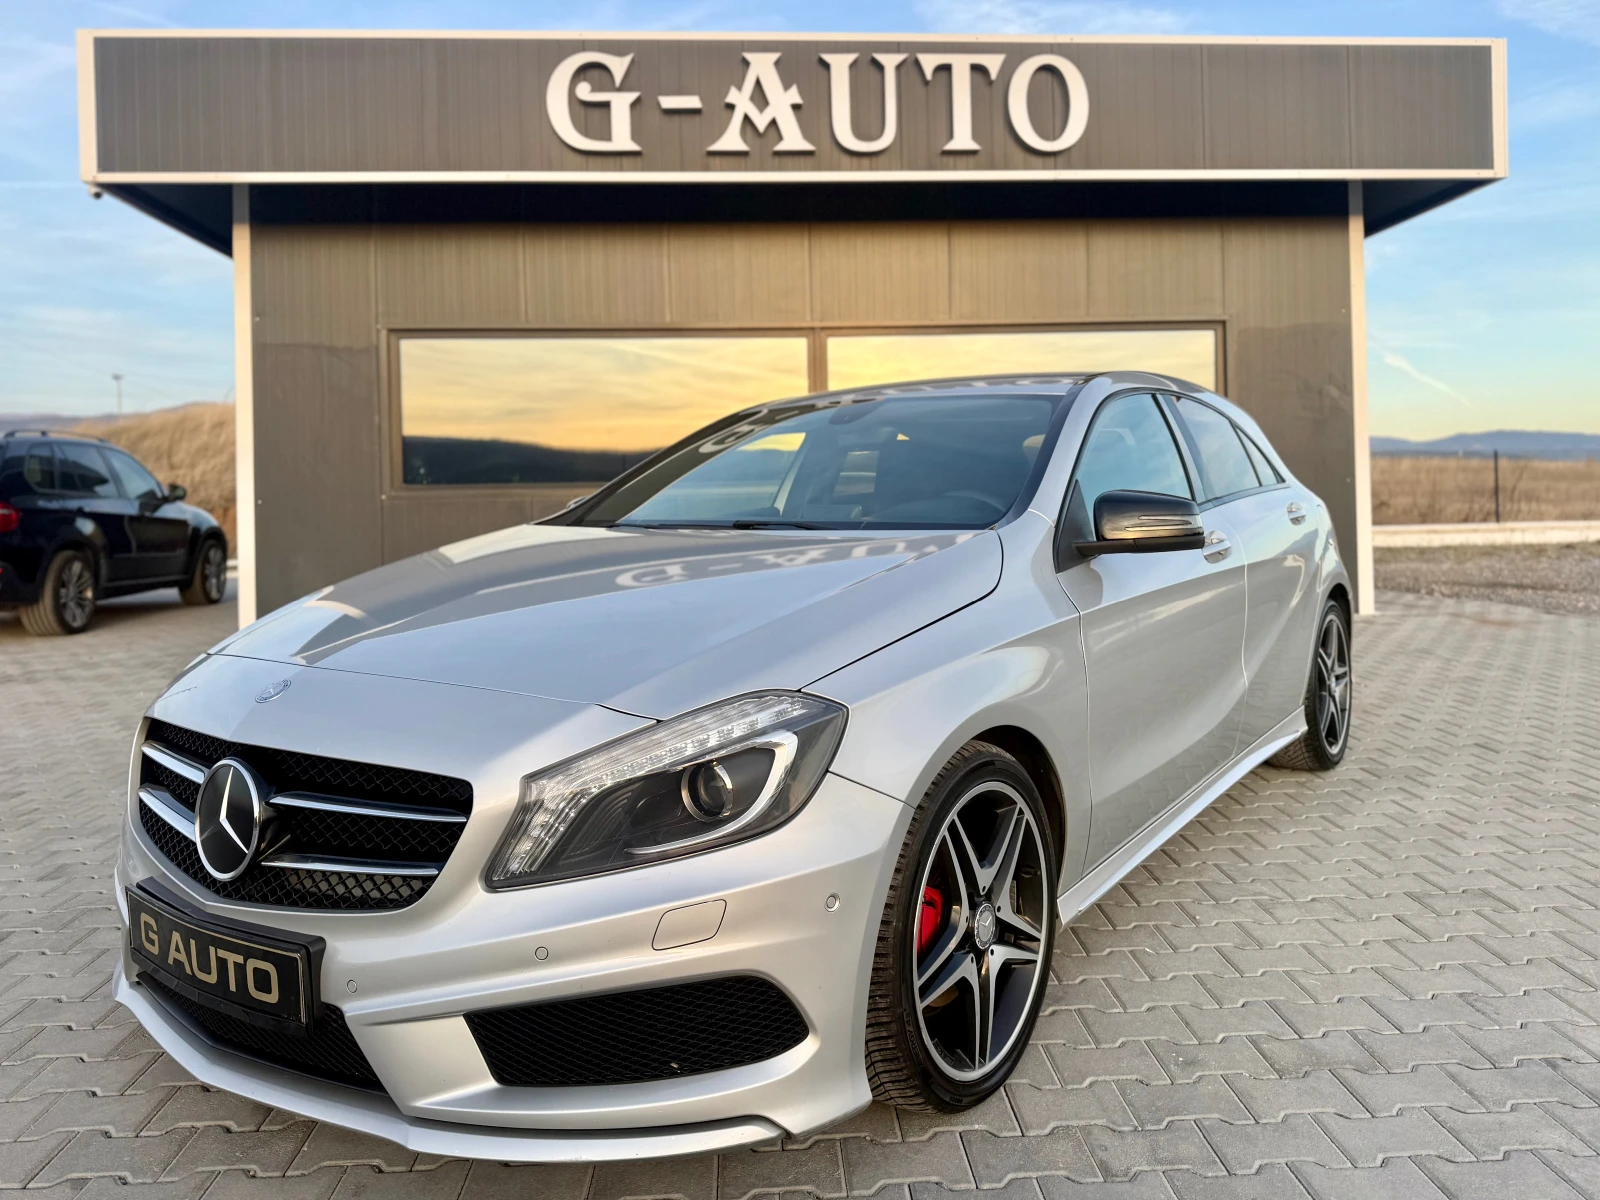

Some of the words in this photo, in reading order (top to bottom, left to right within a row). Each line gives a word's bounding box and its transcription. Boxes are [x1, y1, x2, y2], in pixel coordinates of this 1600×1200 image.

[546, 51, 1090, 153] G-AUTO
[140, 912, 159, 956] G
[167, 930, 279, 1004] AUTO
